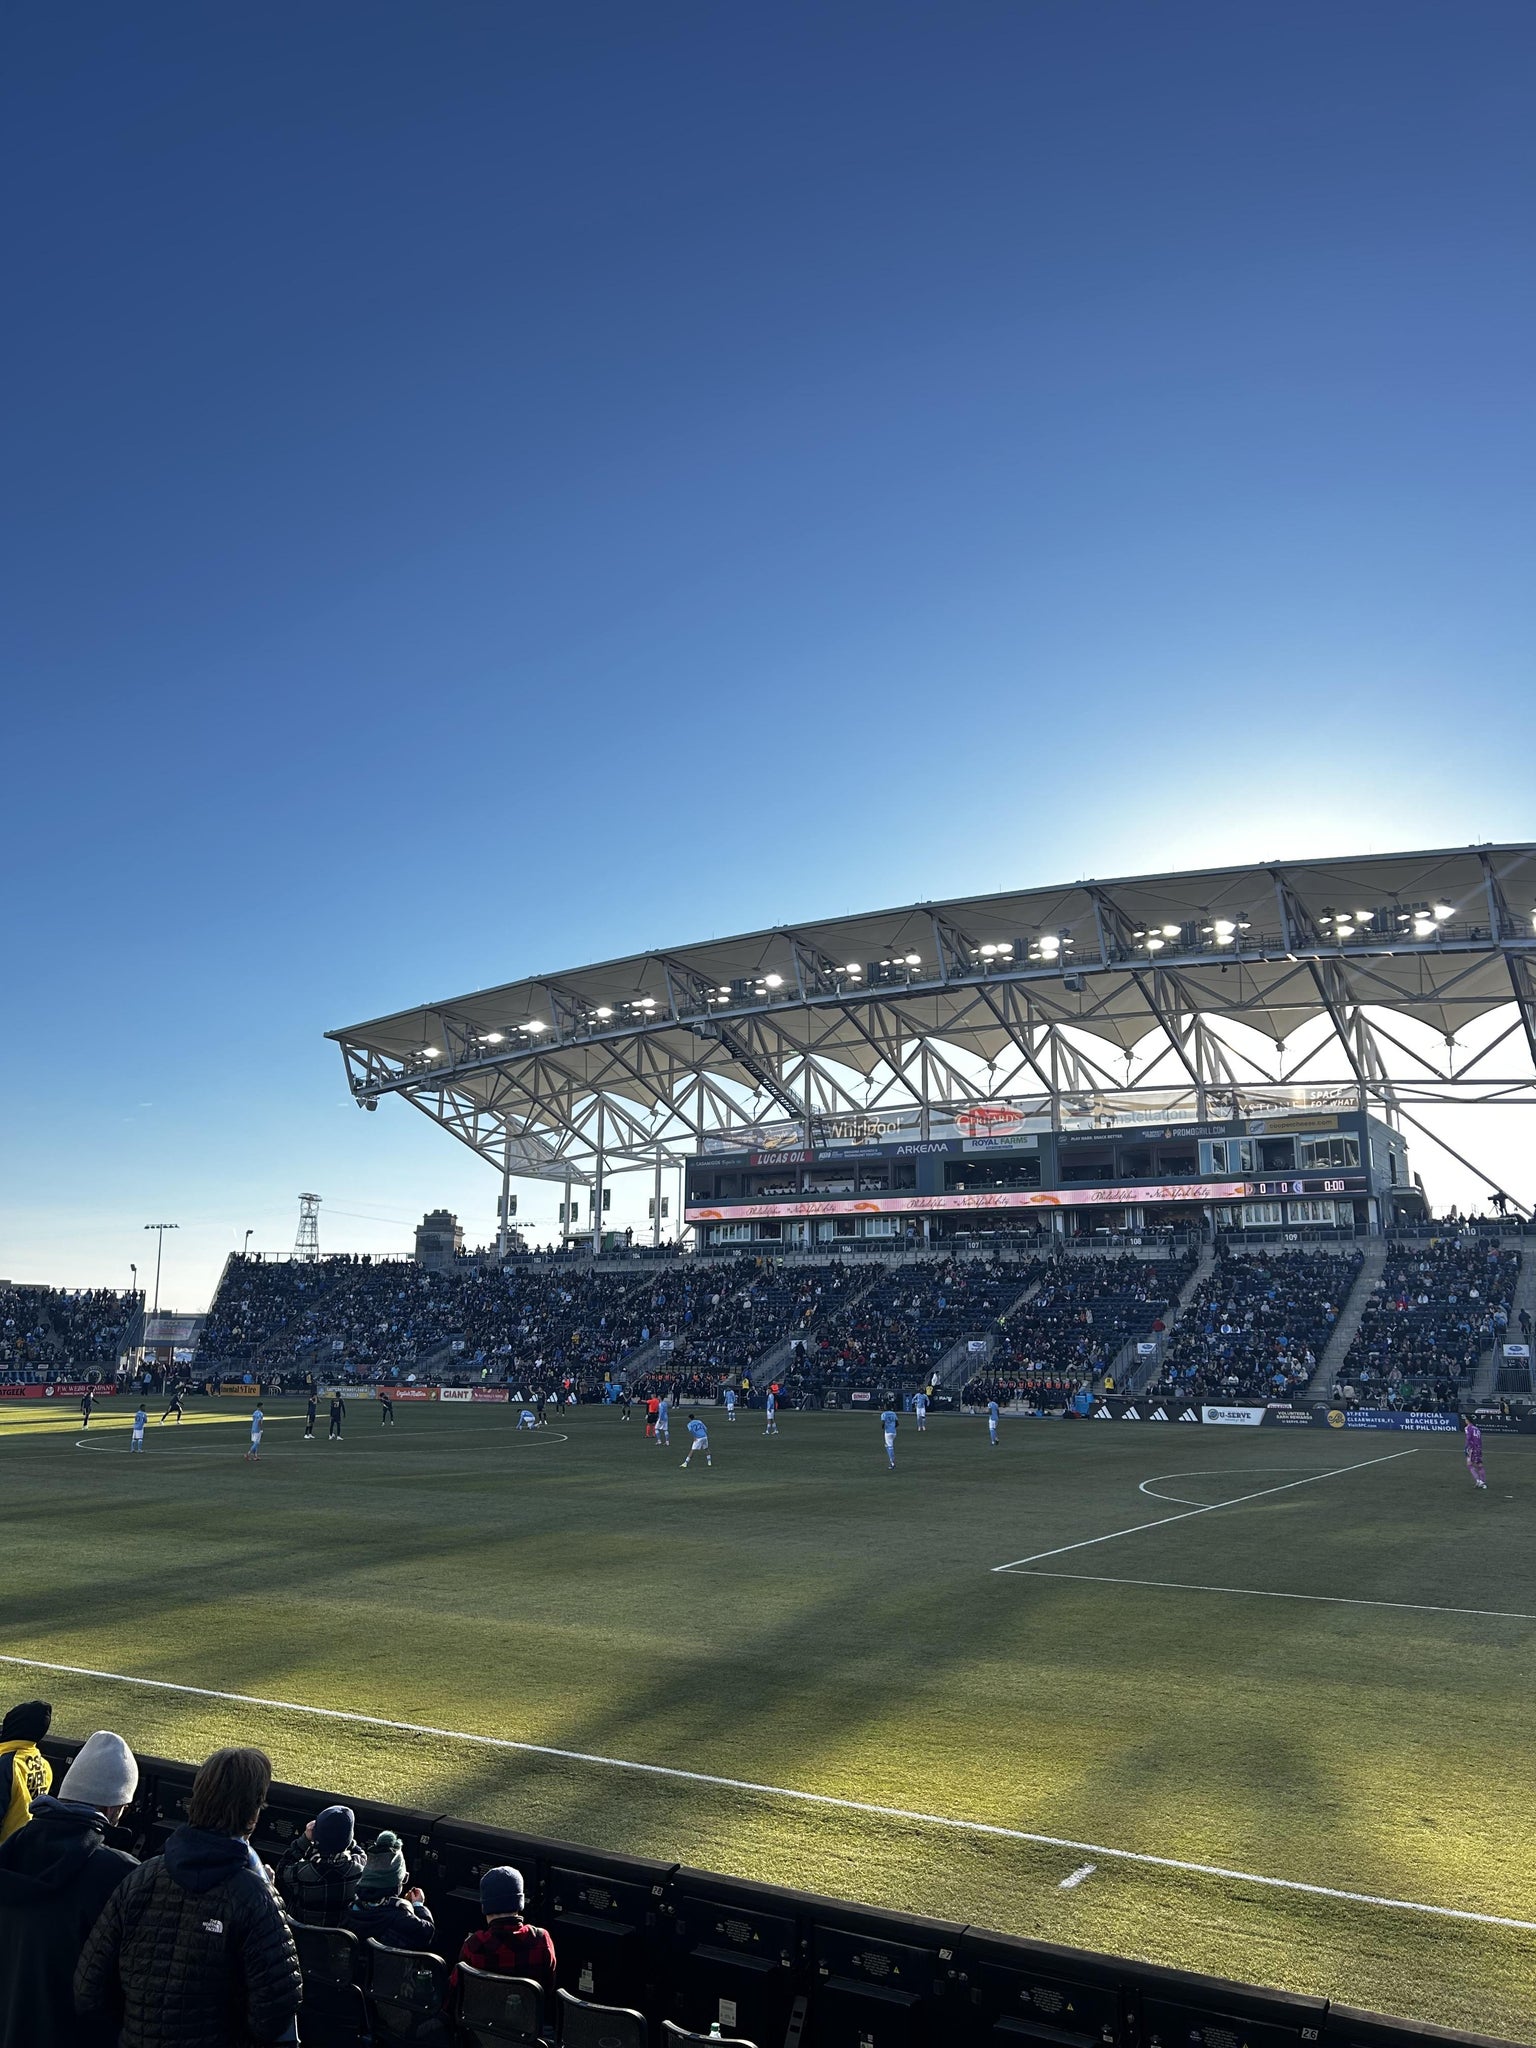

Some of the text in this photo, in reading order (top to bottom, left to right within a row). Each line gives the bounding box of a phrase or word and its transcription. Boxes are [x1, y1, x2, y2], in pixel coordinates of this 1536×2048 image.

[1310, 1089, 1342, 1100] SPACE
[1330, 1098, 1355, 1107] WHAT
[1269, 1119, 1333, 1130] coopercheese.com
[828, 1116, 901, 1146] Whirlpool
[1172, 1126, 1226, 1137] PROMOGRILL.COM
[972, 1136, 1028, 1147] ROYAL FARMS
[896, 1143, 949, 1155] ARKEMA
[757, 1153, 789, 1165] LUCAS
[790, 1151, 806, 1163] OIL
[1260, 1183, 1266, 1194] 0
[1281, 1182, 1288, 1193] 0
[1324, 1180, 1345, 1192] 0:00
[1462, 1227, 1477, 1236] 110
[1130, 1237, 1142, 1245] 108
[1285, 1233, 1298, 1241] 109
[842, 1245, 852, 1253] 106
[968, 1242, 980, 1250] 107
[68, 1385, 86, 1393] WEBB
[86, 1384, 115, 1393] CMPANY
[244, 1385, 257, 1394] Tire
[443, 1390, 469, 1399] GIANT
[1410, 1411, 1444, 1419] OFFICIAL
[1441, 1418, 1450, 1426] OF
[940, 1950, 952, 1958] 27
[1303, 2029, 1317, 2039] 26
